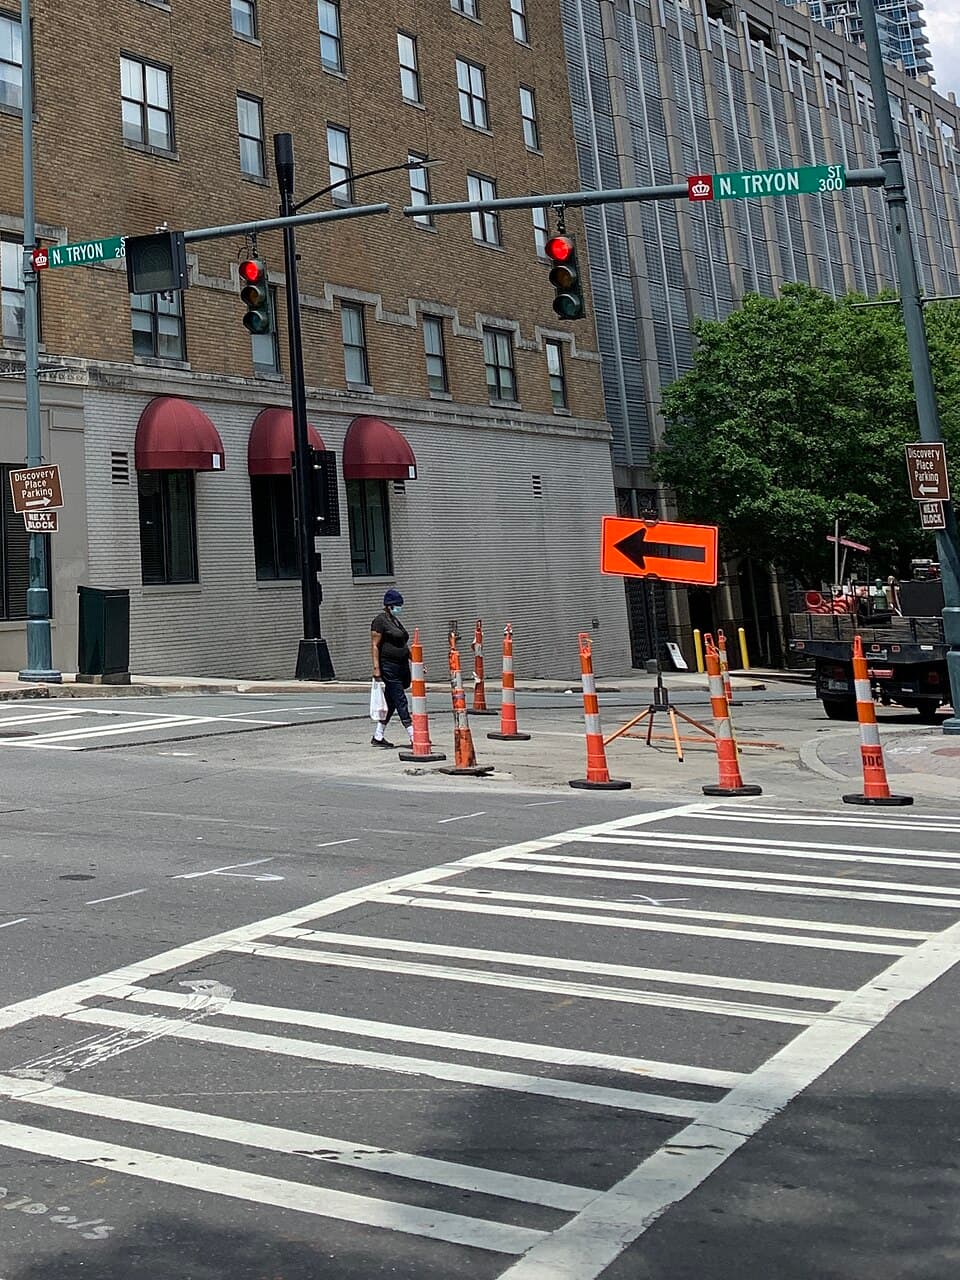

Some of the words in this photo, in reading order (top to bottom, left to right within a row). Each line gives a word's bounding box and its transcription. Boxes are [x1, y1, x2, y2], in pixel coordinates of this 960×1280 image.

[828, 165, 841, 178] ST
[720, 178, 737, 196] N.
[742, 171, 800, 194] TRYON
[818, 178, 843, 191] 300
[52, 249, 64, 264] N.
[66, 242, 104, 262] TRYON
[115, 248, 126, 258] 20
[907, 448, 941, 461] Discovery
[916, 459, 934, 470] Place
[14, 470, 55, 482] Discovery
[914, 470, 939, 485] Parking
[24, 480, 47, 489] Place
[21, 488, 53, 499] Parking
[922, 503, 939, 514] NEXT
[28, 513, 52, 521] NEXT
[923, 514, 943, 524] BLOCK
[27, 521, 55, 529] BLOCK
